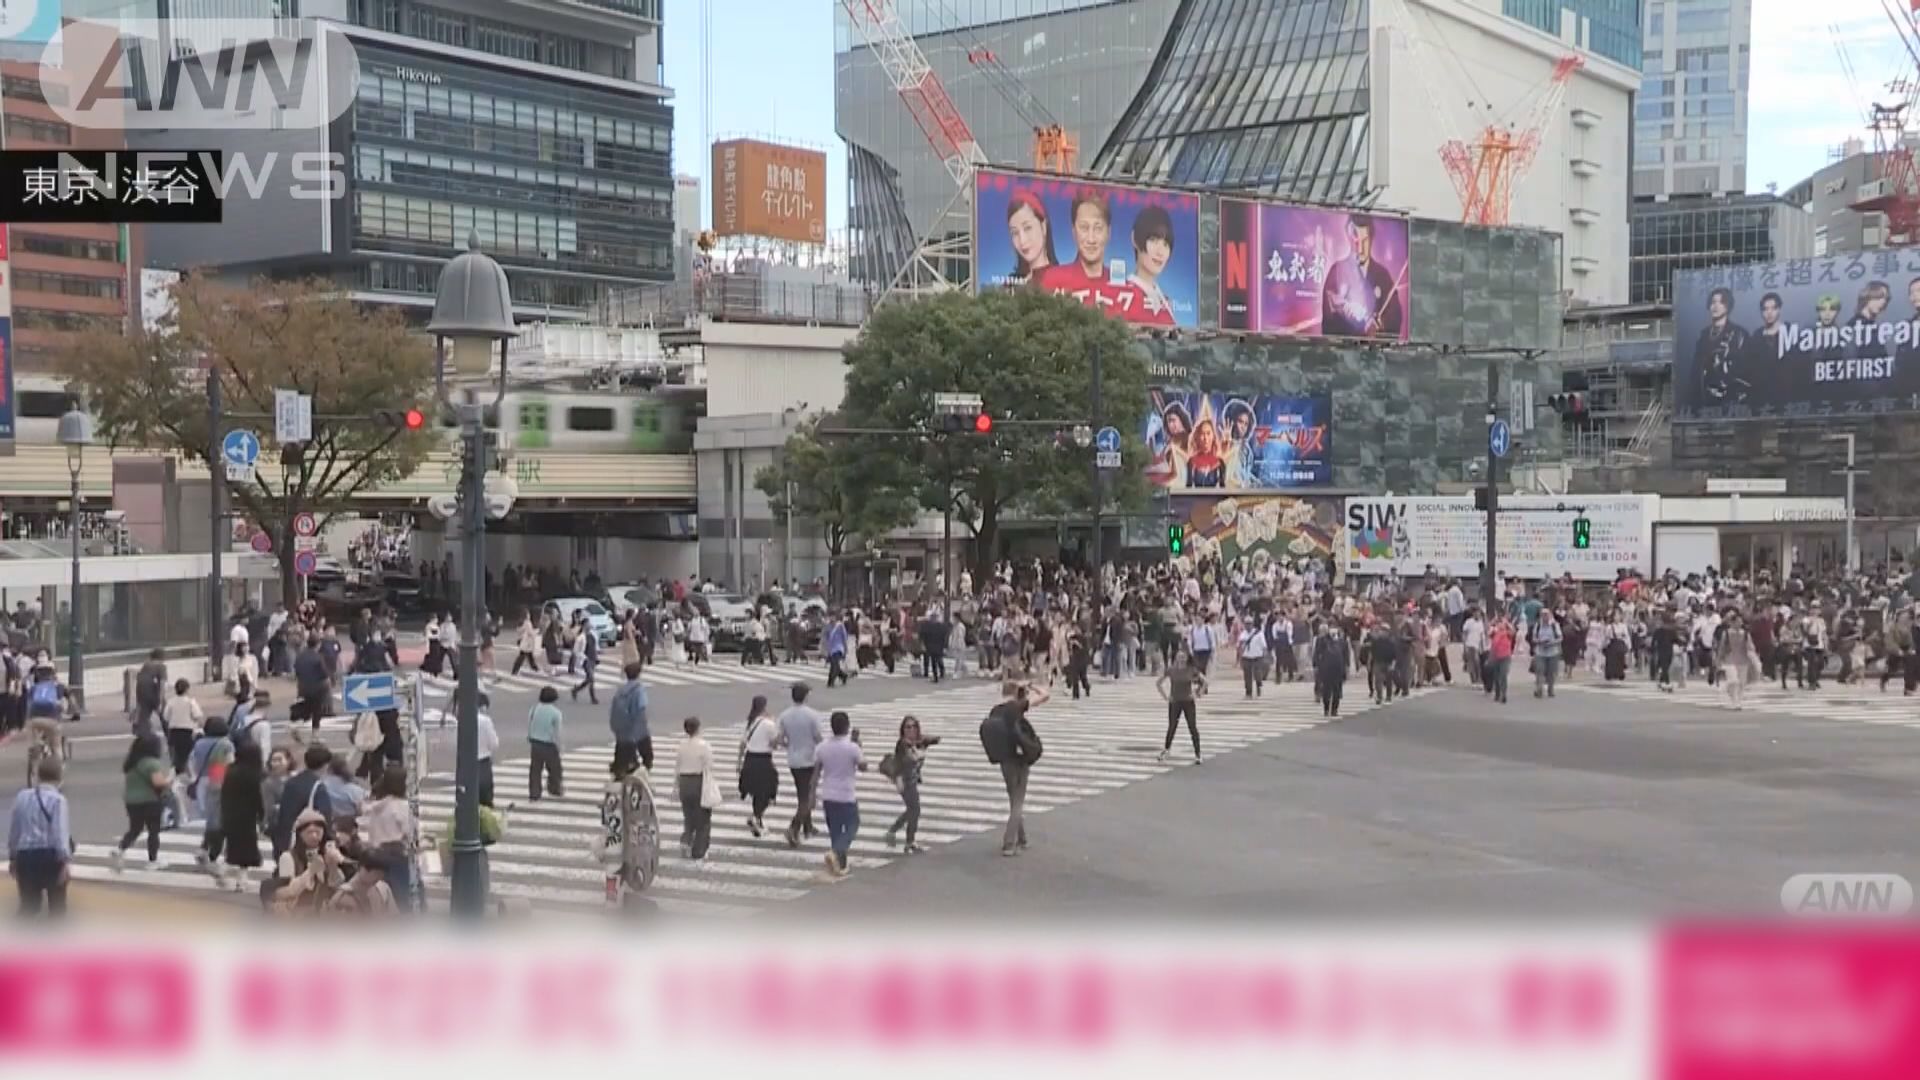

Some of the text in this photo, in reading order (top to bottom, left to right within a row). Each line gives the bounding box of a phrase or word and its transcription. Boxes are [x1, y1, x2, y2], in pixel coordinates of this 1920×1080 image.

[1226, 241, 1248, 290] N
[1266, 249, 1326, 284] 鬼武者
[1152, 362, 1187, 378] tation
